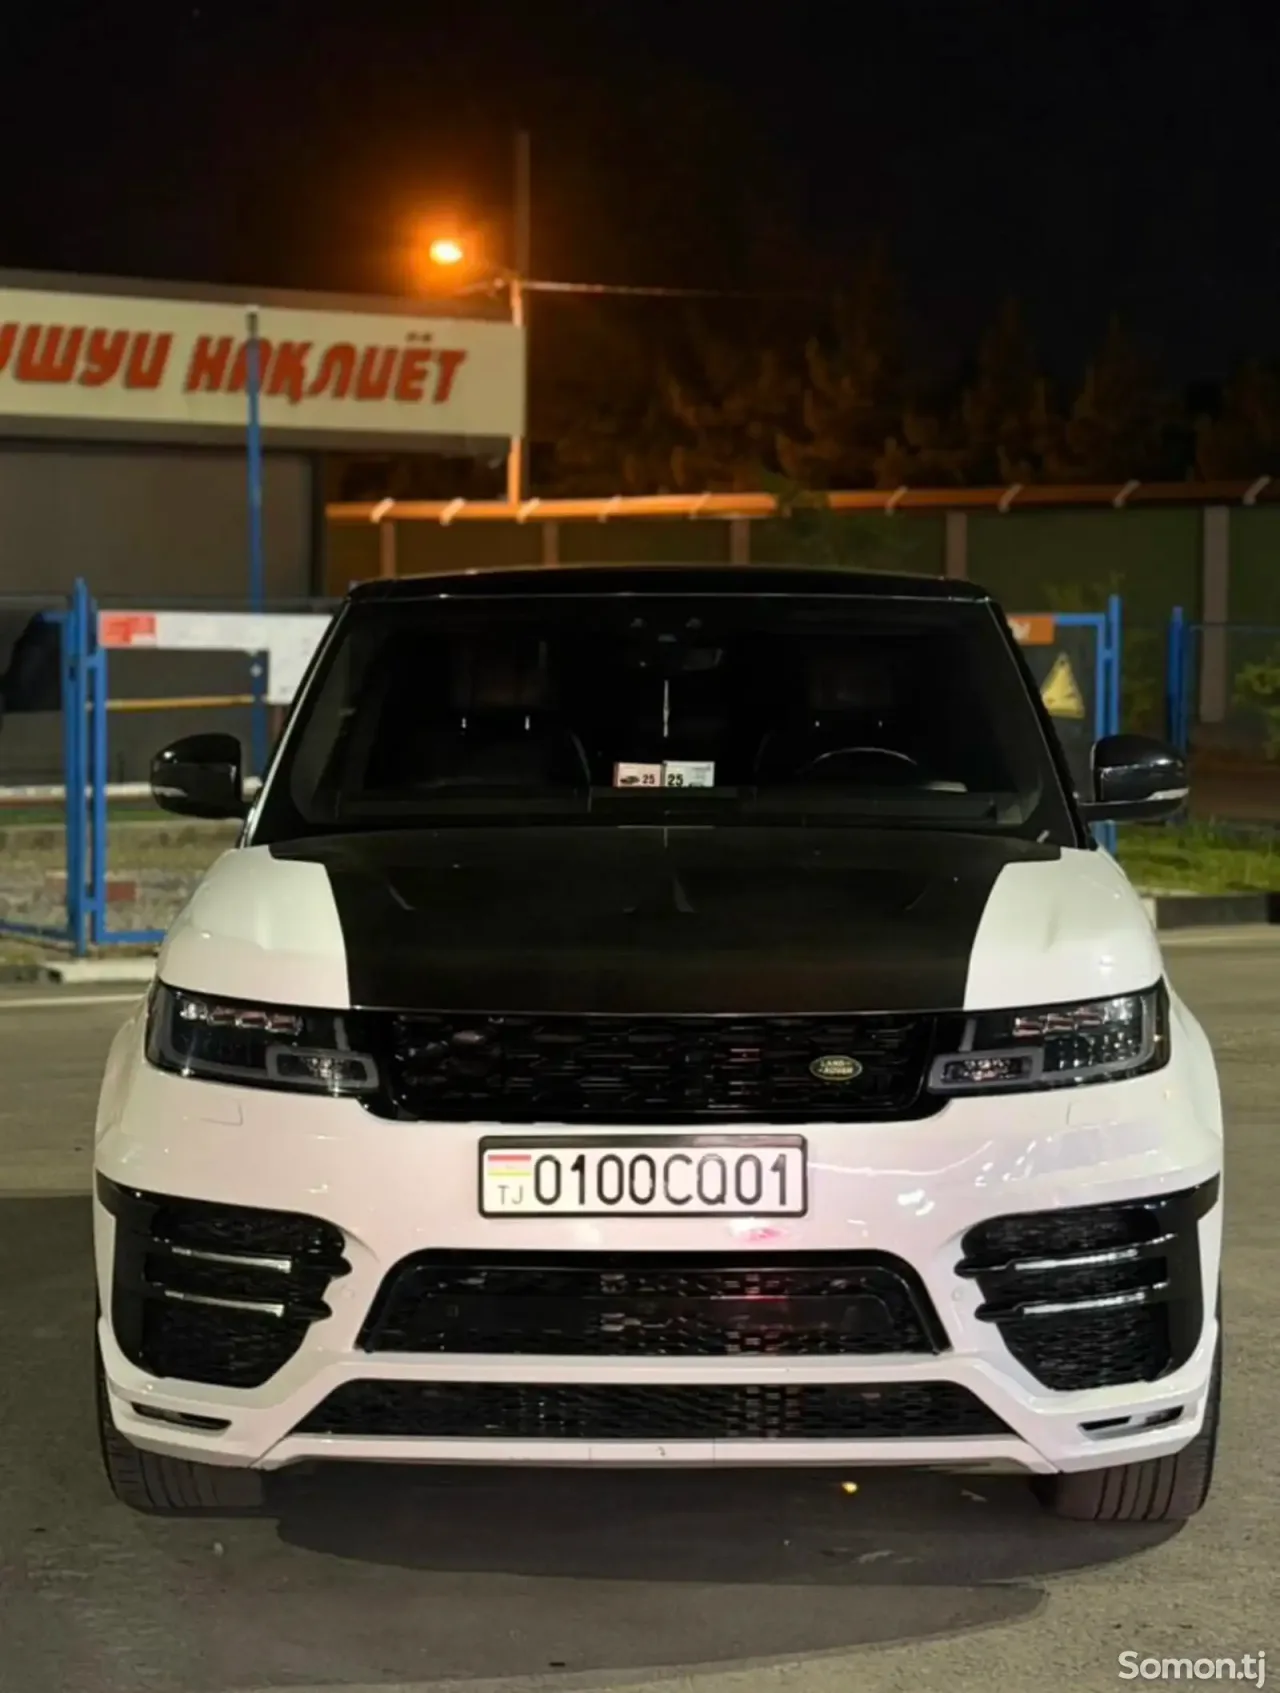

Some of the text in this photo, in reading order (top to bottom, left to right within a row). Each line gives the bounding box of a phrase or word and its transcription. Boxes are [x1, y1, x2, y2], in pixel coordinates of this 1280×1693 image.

[667, 773, 684, 786] 25
[498, 1154, 788, 1207] TJ 0100CQ01
